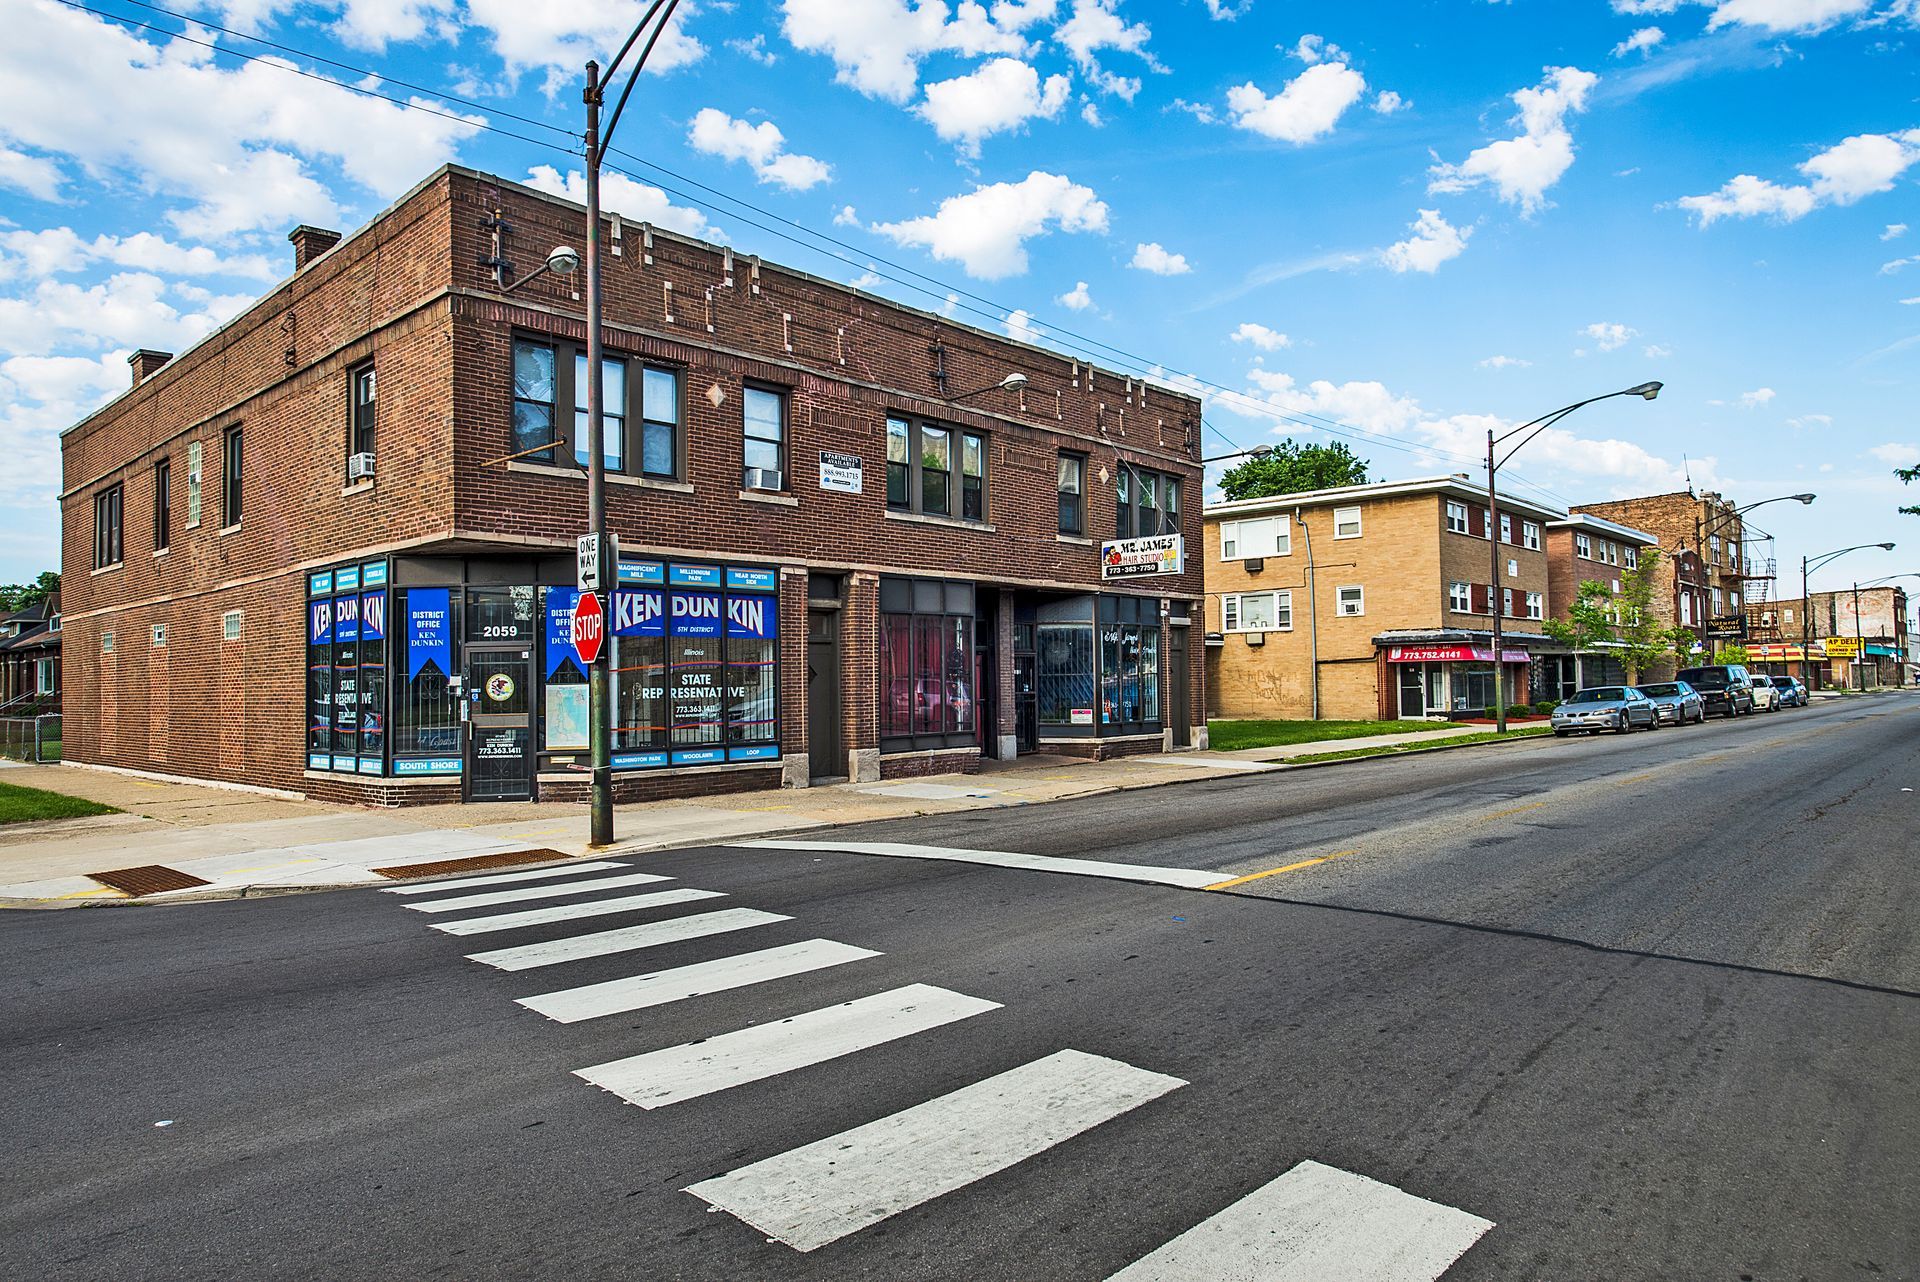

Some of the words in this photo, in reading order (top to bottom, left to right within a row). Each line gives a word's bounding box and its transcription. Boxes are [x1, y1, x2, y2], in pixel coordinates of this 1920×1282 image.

[824, 453, 858, 464] APARTMENTS
[828, 459, 855, 467] AVAILABLE
[824, 469, 858, 479] 888.993.1715
[580, 539, 596, 553] ONE
[580, 554, 596, 568] WAY
[1122, 555, 1138, 564] HAIR
[1140, 552, 1164, 563] STUDIO
[618, 564, 656, 572] MAGNIFICENT
[680, 568, 710, 576] MILLENNIUM
[412, 611, 444, 619] DISTRICT
[615, 592, 662, 632] KEN
[313, 604, 331, 641] KEN
[576, 614, 600, 641] STOP
[484, 626, 518, 637] 2059
[1404, 651, 1460, 659] 773.752.4141
[682, 674, 711, 685] STATE
[341, 680, 355, 691] STATE
[400, 762, 427, 770] SOUTH
[431, 761, 458, 769] SHORE
